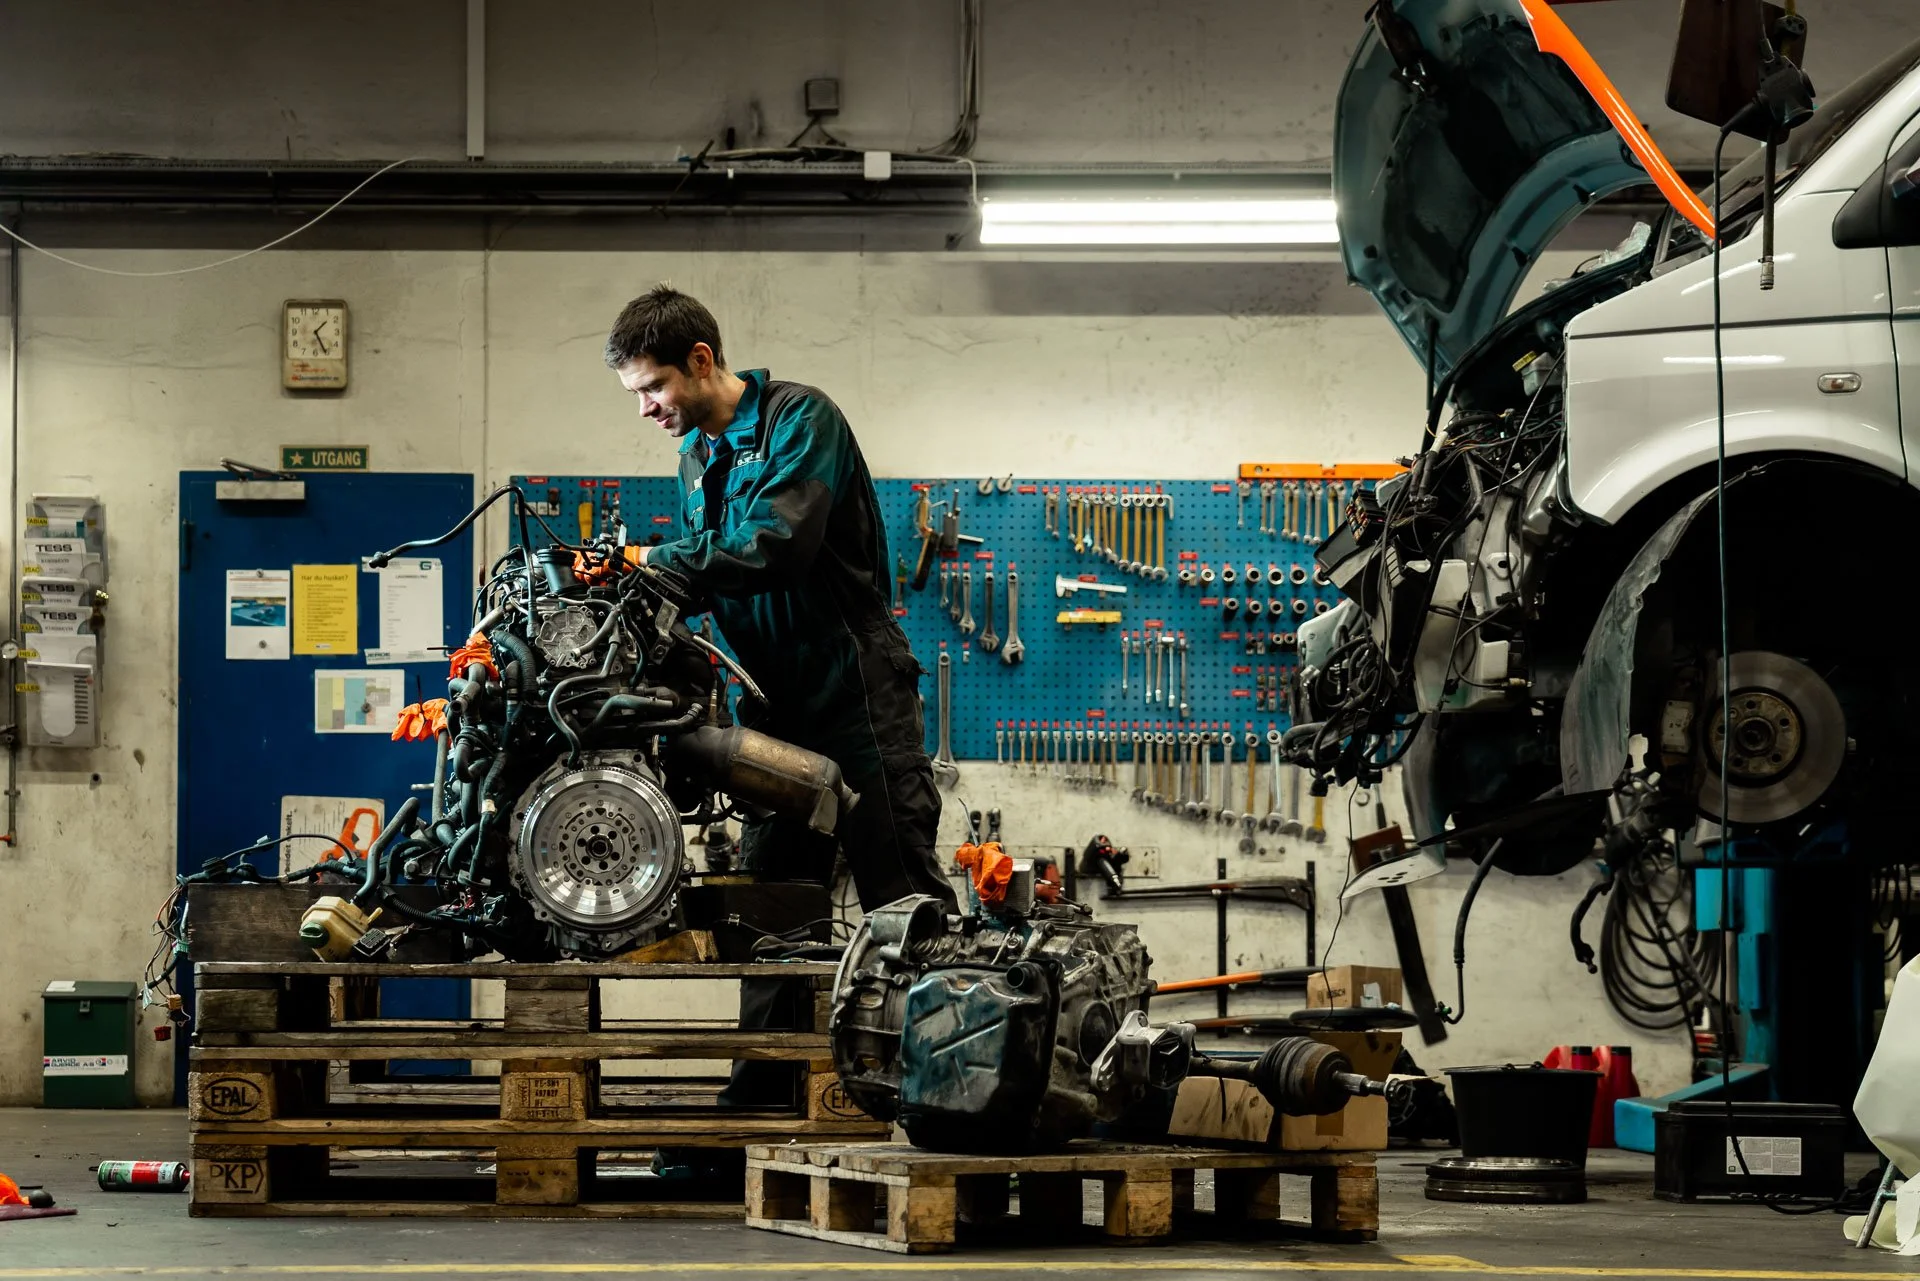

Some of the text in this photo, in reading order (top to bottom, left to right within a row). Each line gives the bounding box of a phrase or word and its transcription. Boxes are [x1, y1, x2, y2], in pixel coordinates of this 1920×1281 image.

[312, 306, 320, 316] 12
[312, 451, 361, 466] UTGANG
[36, 544, 72, 552] TESS
[38, 584, 75, 593] TESS
[40, 611, 77, 620] TESS
[211, 1086, 253, 1107] EPAL
